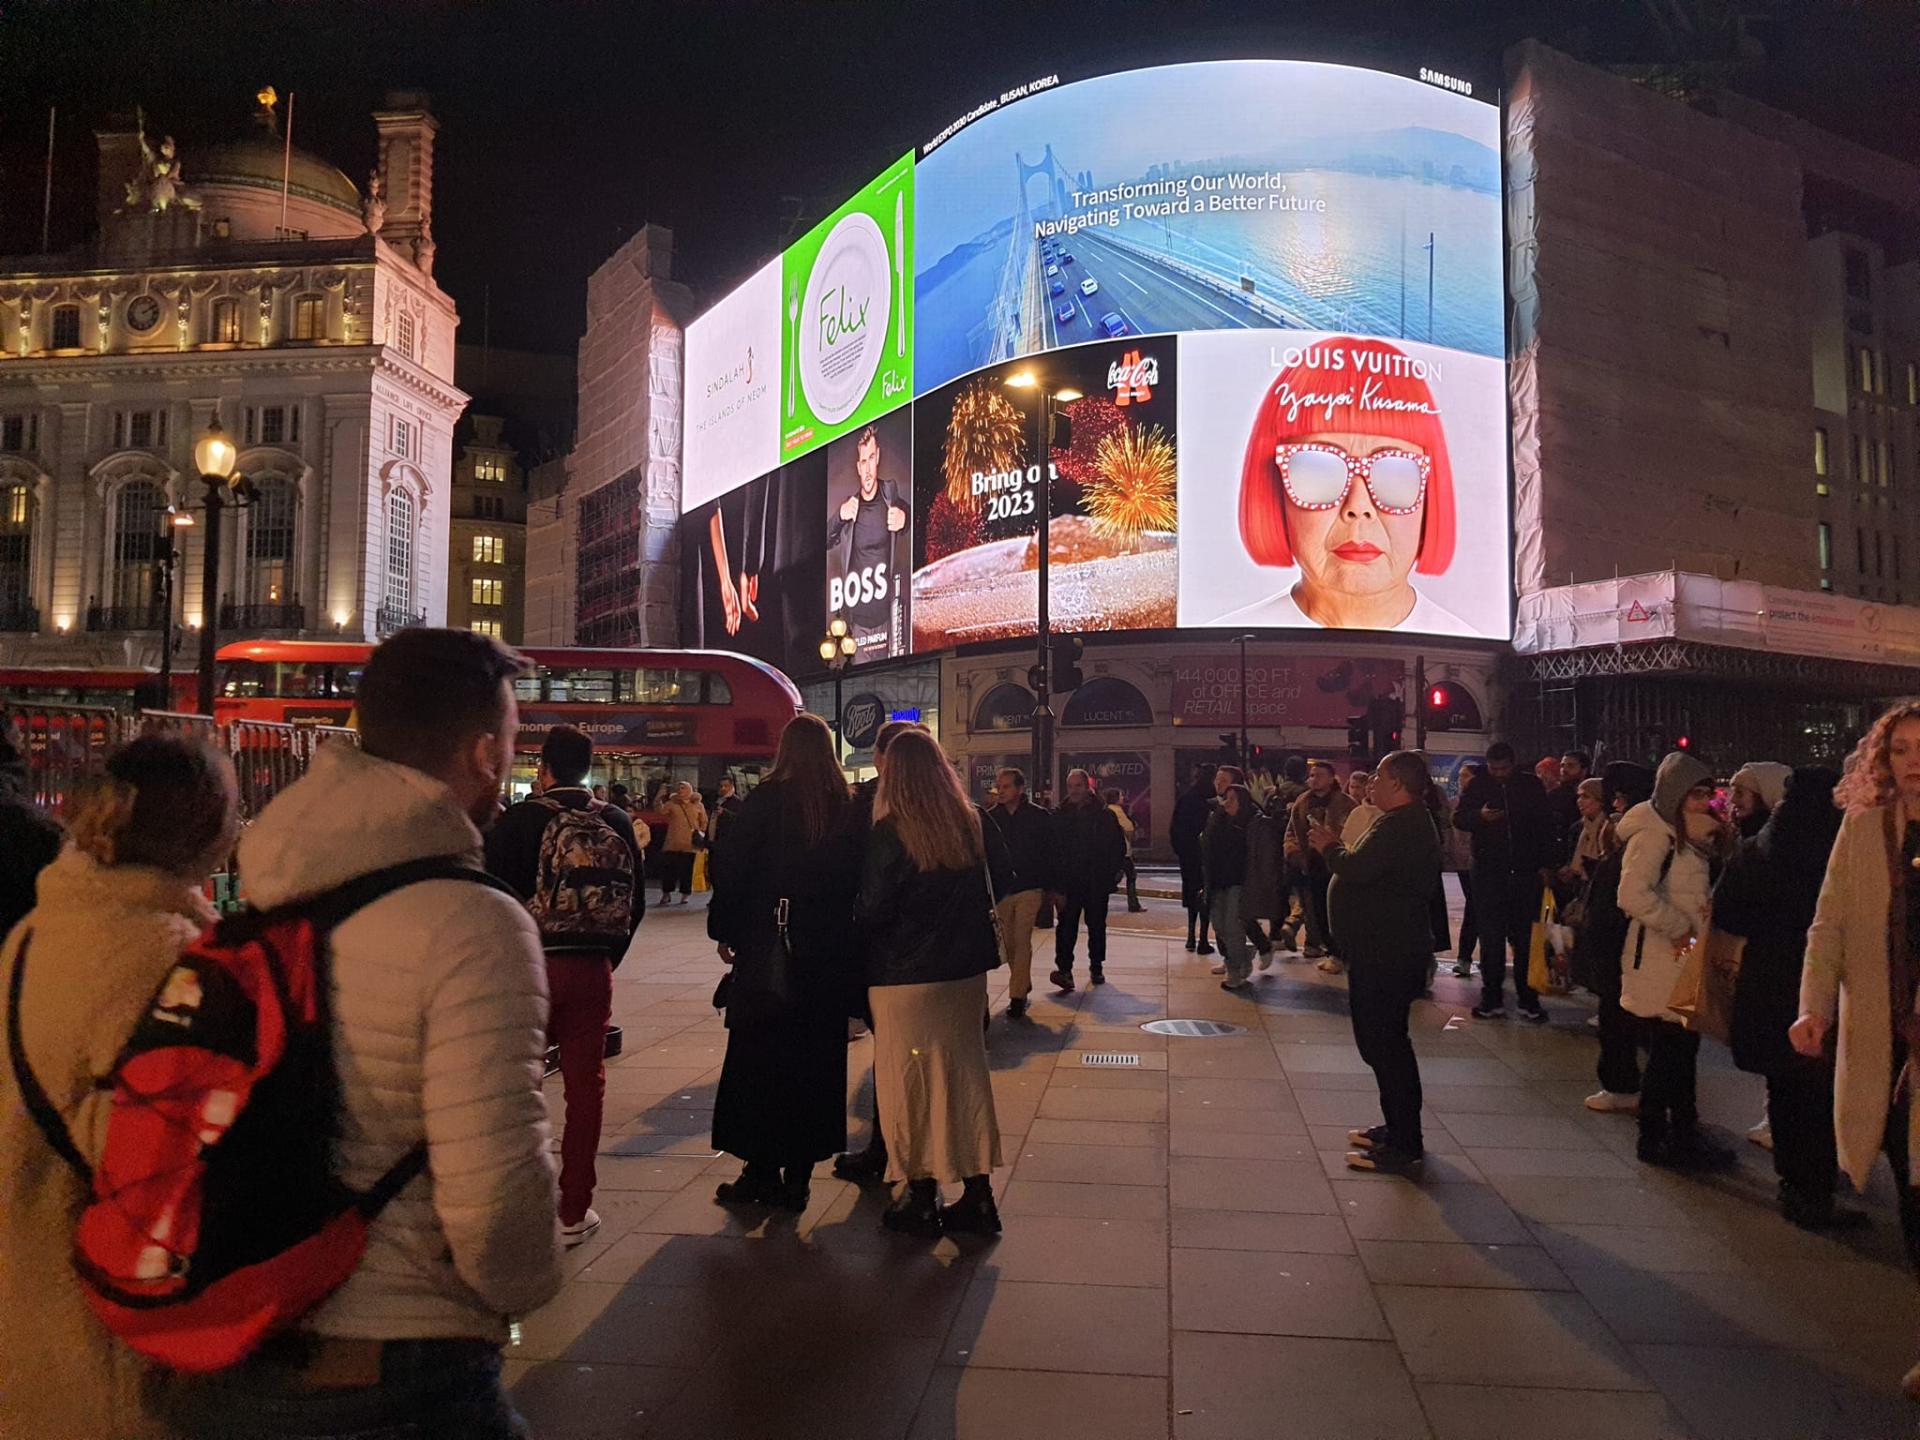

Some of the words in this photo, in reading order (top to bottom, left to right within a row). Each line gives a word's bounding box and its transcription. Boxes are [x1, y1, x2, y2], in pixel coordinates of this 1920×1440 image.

[1420, 67, 1472, 95] SAMSUNG
[923, 137, 939, 154] World
[939, 125, 953, 144] EXPO
[1029, 74, 1059, 92] KOREA
[1072, 178, 1187, 208] Transforming
[1191, 175, 1225, 191] Our
[1228, 172, 1287, 192] World,
[1035, 208, 1120, 239] Navigating
[1123, 196, 1190, 219] Toward
[1194, 199, 1205, 212] a
[1209, 195, 1266, 211] Better
[1269, 194, 1327, 212] Future
[819, 285, 871, 352] Felix
[705, 363, 745, 398] SINDALAH
[1270, 346, 1346, 370] LOUIS
[1351, 350, 1443, 382] VUITTON
[882, 370, 907, 400] Felix
[1359, 376, 1442, 414] Kusama
[971, 467, 1022, 496] Bring
[987, 490, 1035, 521] 2023
[830, 563, 888, 612] BOSS
[1174, 667, 1241, 683] 144,000
[1272, 667, 1291, 683] FT
[1192, 684, 1208, 699] of
[1210, 684, 1271, 699] OFFCE
[1271, 684, 1301, 699] and
[846, 703, 876, 738] Boots
[1183, 699, 1236, 714] RETAIL
[578, 722, 628, 735] Europe.
[976, 765, 997, 776] PRIM
